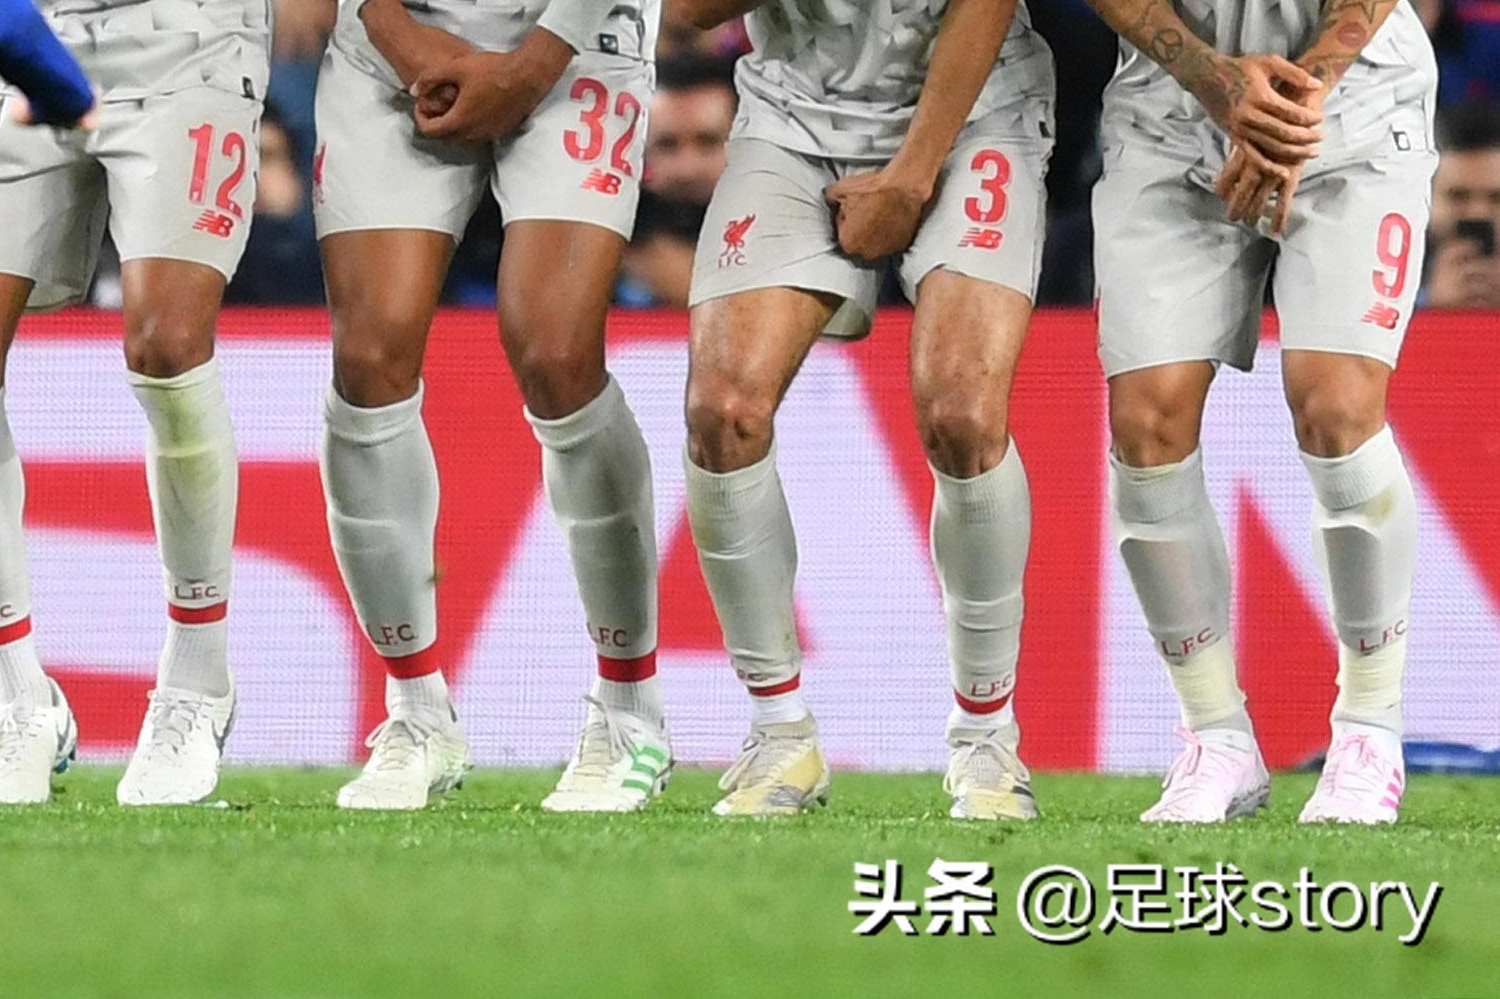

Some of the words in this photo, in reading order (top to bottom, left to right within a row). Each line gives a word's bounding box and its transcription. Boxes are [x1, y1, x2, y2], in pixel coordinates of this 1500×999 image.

[187, 123, 247, 218] 12
[563, 77, 641, 178] 32
[964, 148, 1011, 224] 3
[1372, 212, 1411, 299] 9
